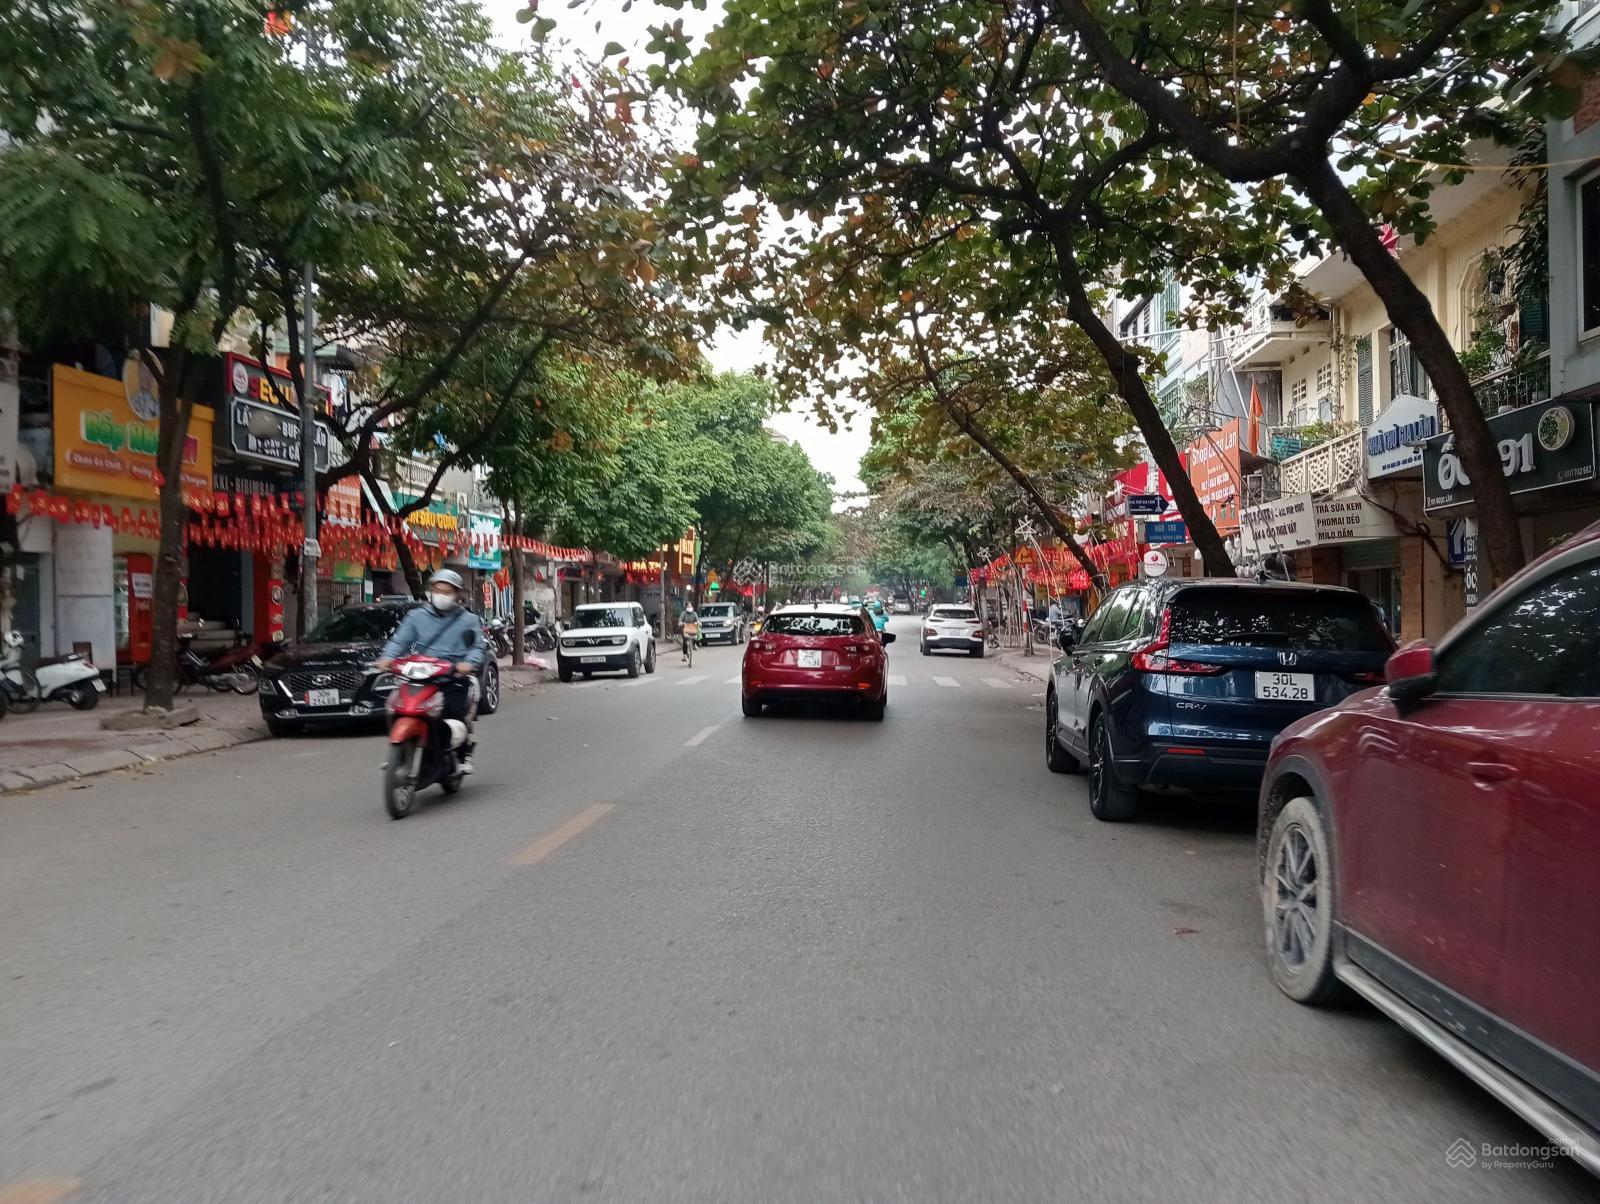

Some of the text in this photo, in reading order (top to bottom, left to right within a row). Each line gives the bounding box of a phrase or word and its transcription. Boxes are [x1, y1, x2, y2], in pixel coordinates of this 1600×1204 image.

[1225, 431, 1237, 450] Lan
[1315, 503, 1329, 514] TRÀ
[1346, 502, 1362, 511] KEM
[1317, 516, 1345, 527] PHOMAI
[1272, 674, 1297, 686] 30L
[1262, 686, 1308, 700] 534.28
